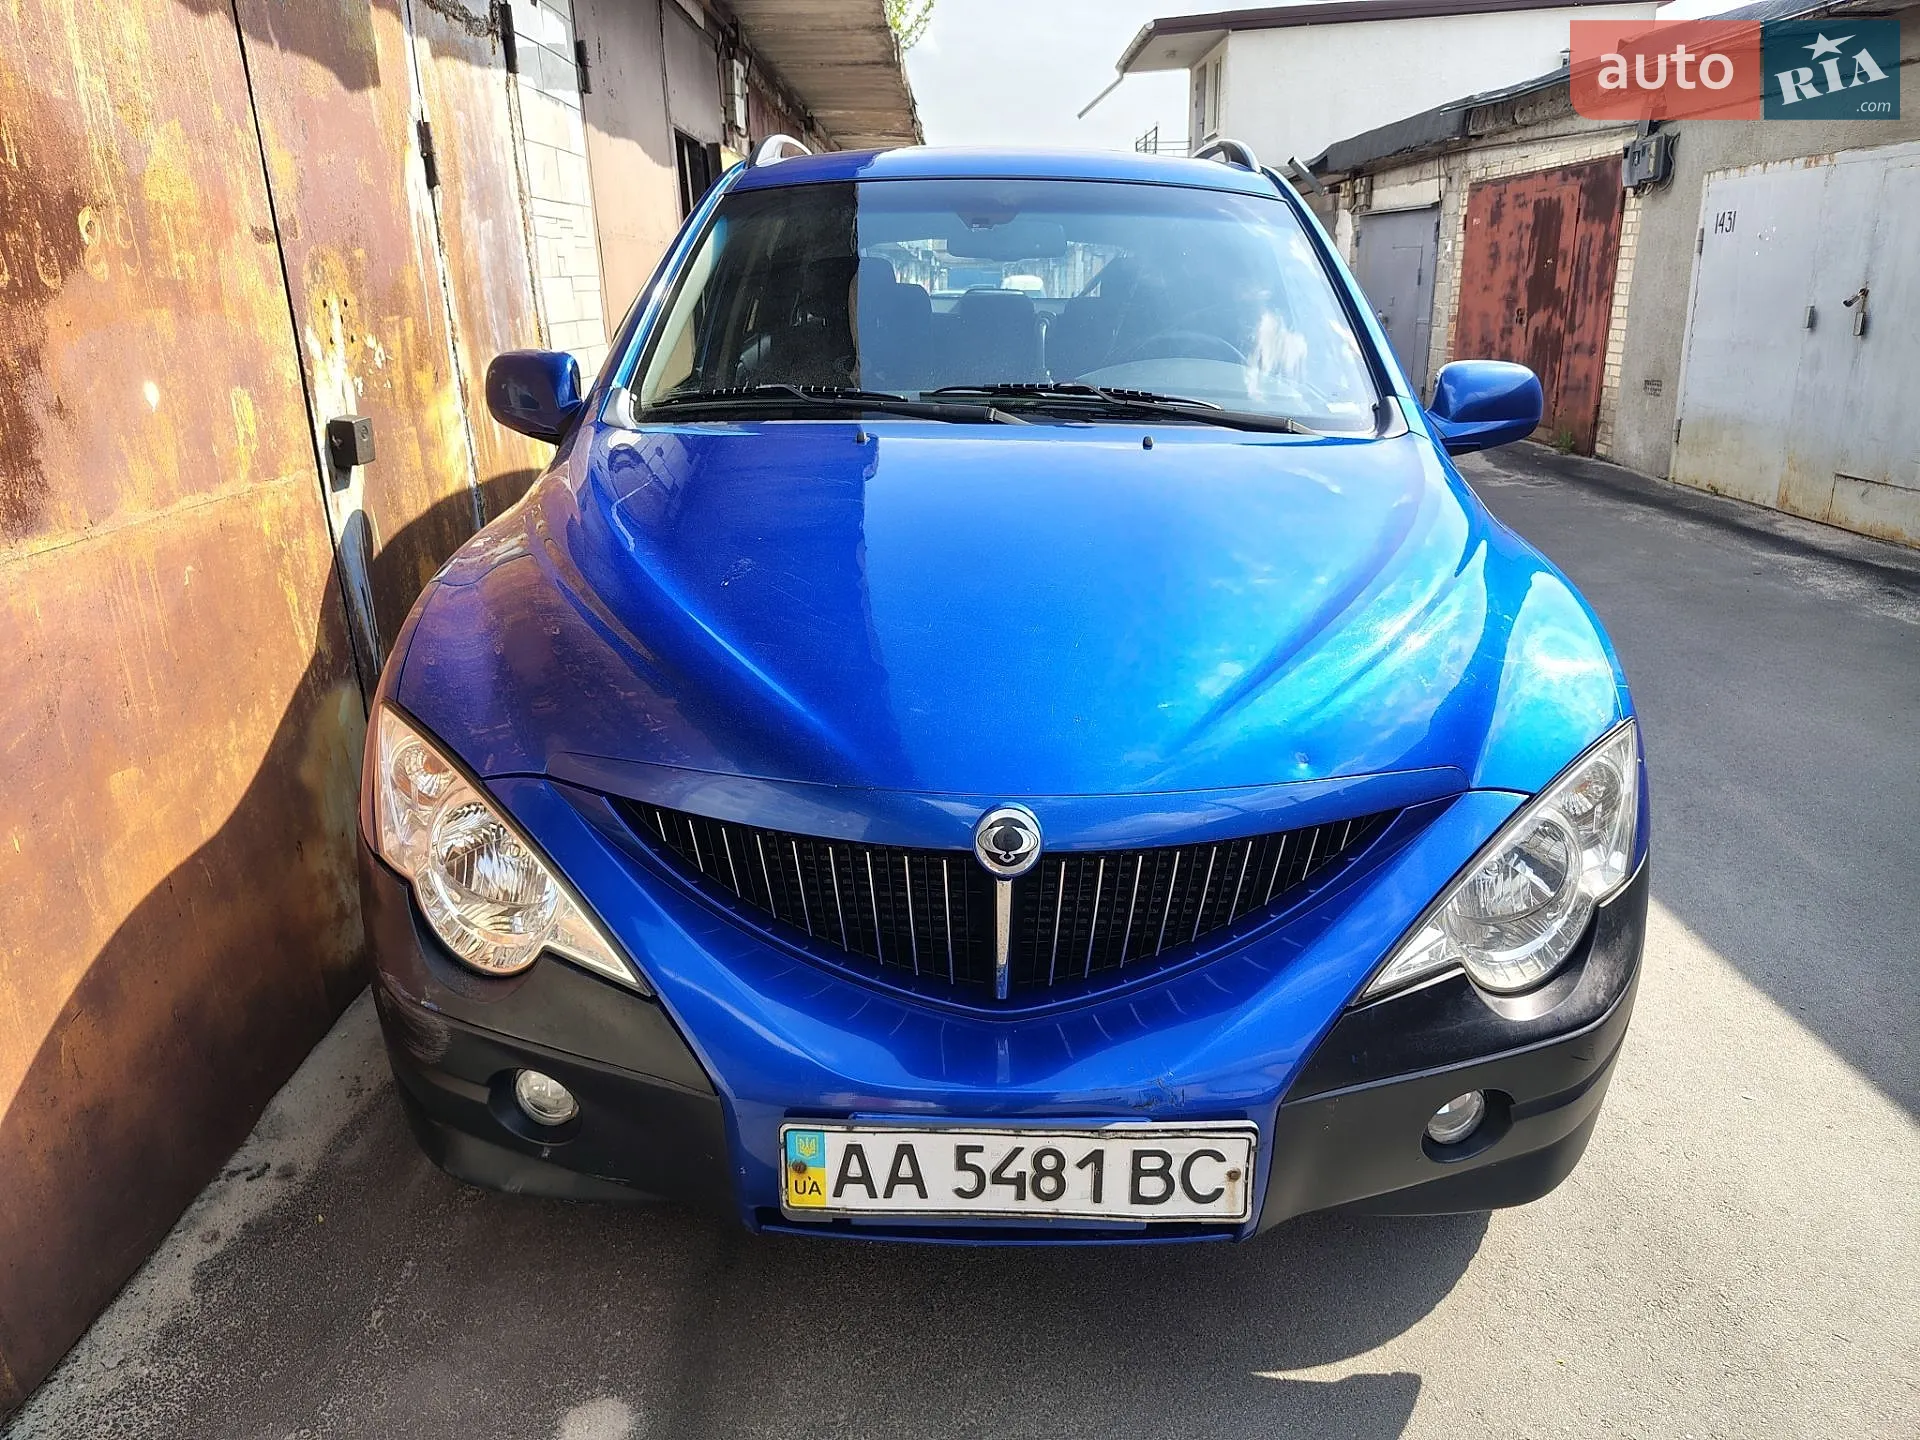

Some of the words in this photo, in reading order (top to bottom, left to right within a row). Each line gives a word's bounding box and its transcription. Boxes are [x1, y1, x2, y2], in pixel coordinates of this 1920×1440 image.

[1714, 210, 1737, 234] 1431
[833, 1143, 929, 1199] AA
[953, 1145, 1105, 1204] 5481
[1130, 1149, 1228, 1205] BC
[794, 1179, 822, 1196] UA
